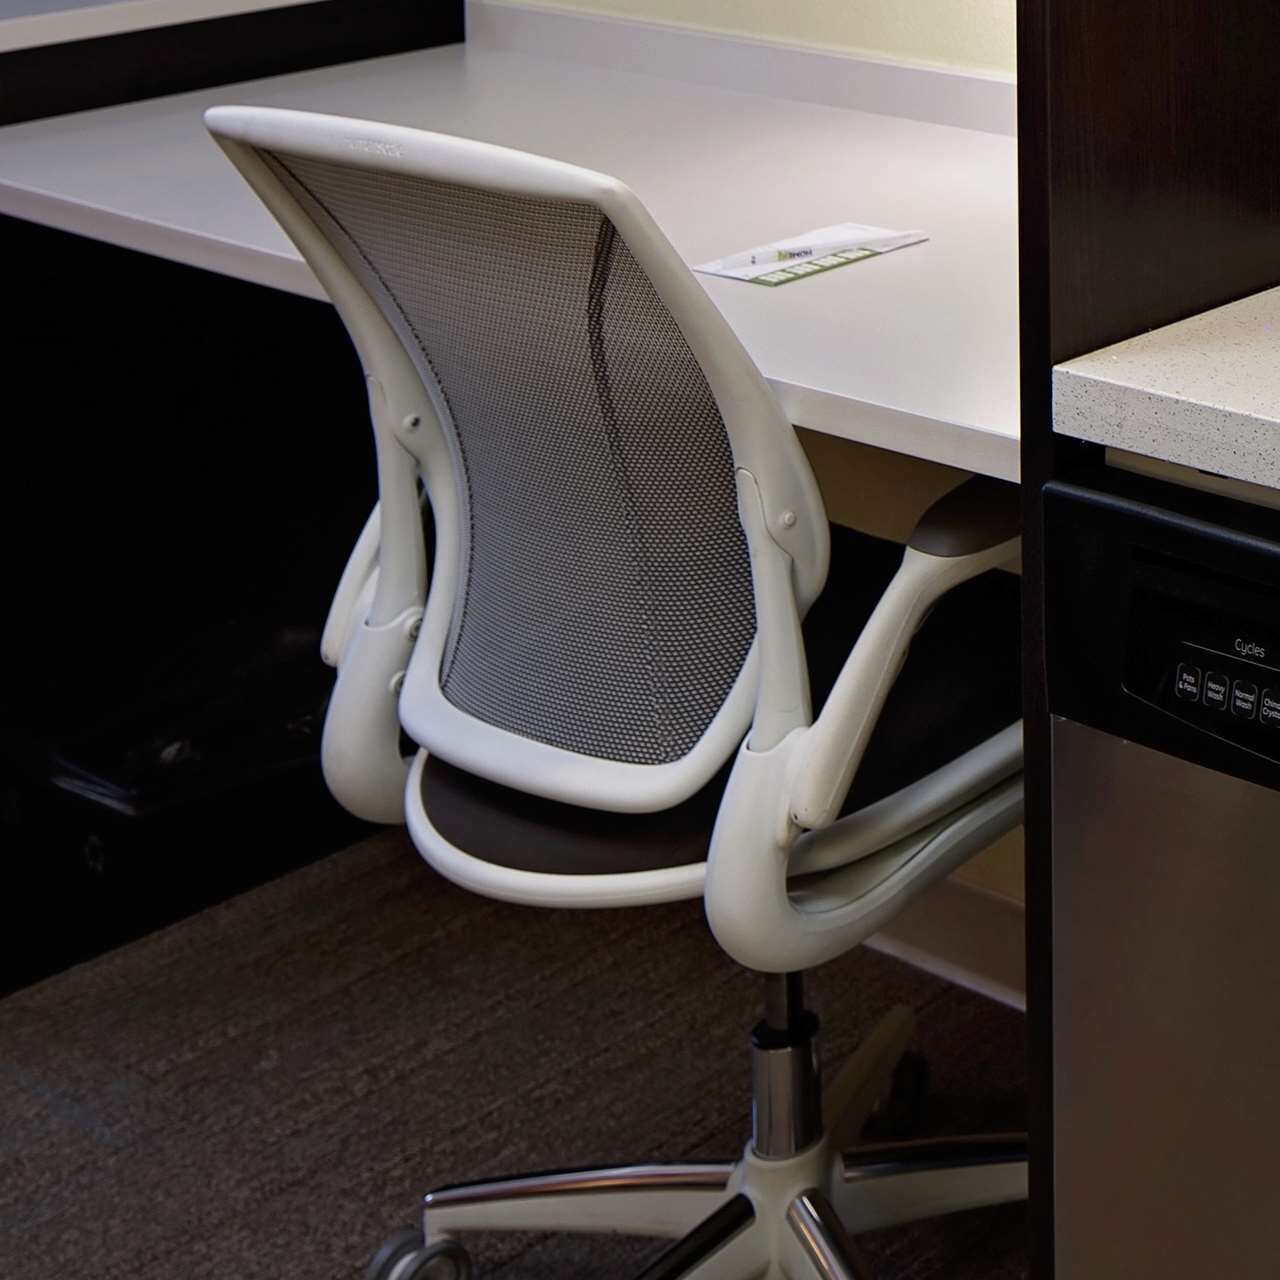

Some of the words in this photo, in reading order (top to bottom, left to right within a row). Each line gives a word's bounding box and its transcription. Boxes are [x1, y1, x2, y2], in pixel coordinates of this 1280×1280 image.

[1234, 638, 1265, 658] Cycles
[1207, 681, 1226, 694] Heavy
[1207, 690, 1223, 701] Wash
[1235, 689, 1255, 701] Normal
[1236, 699, 1252, 710] Wash
